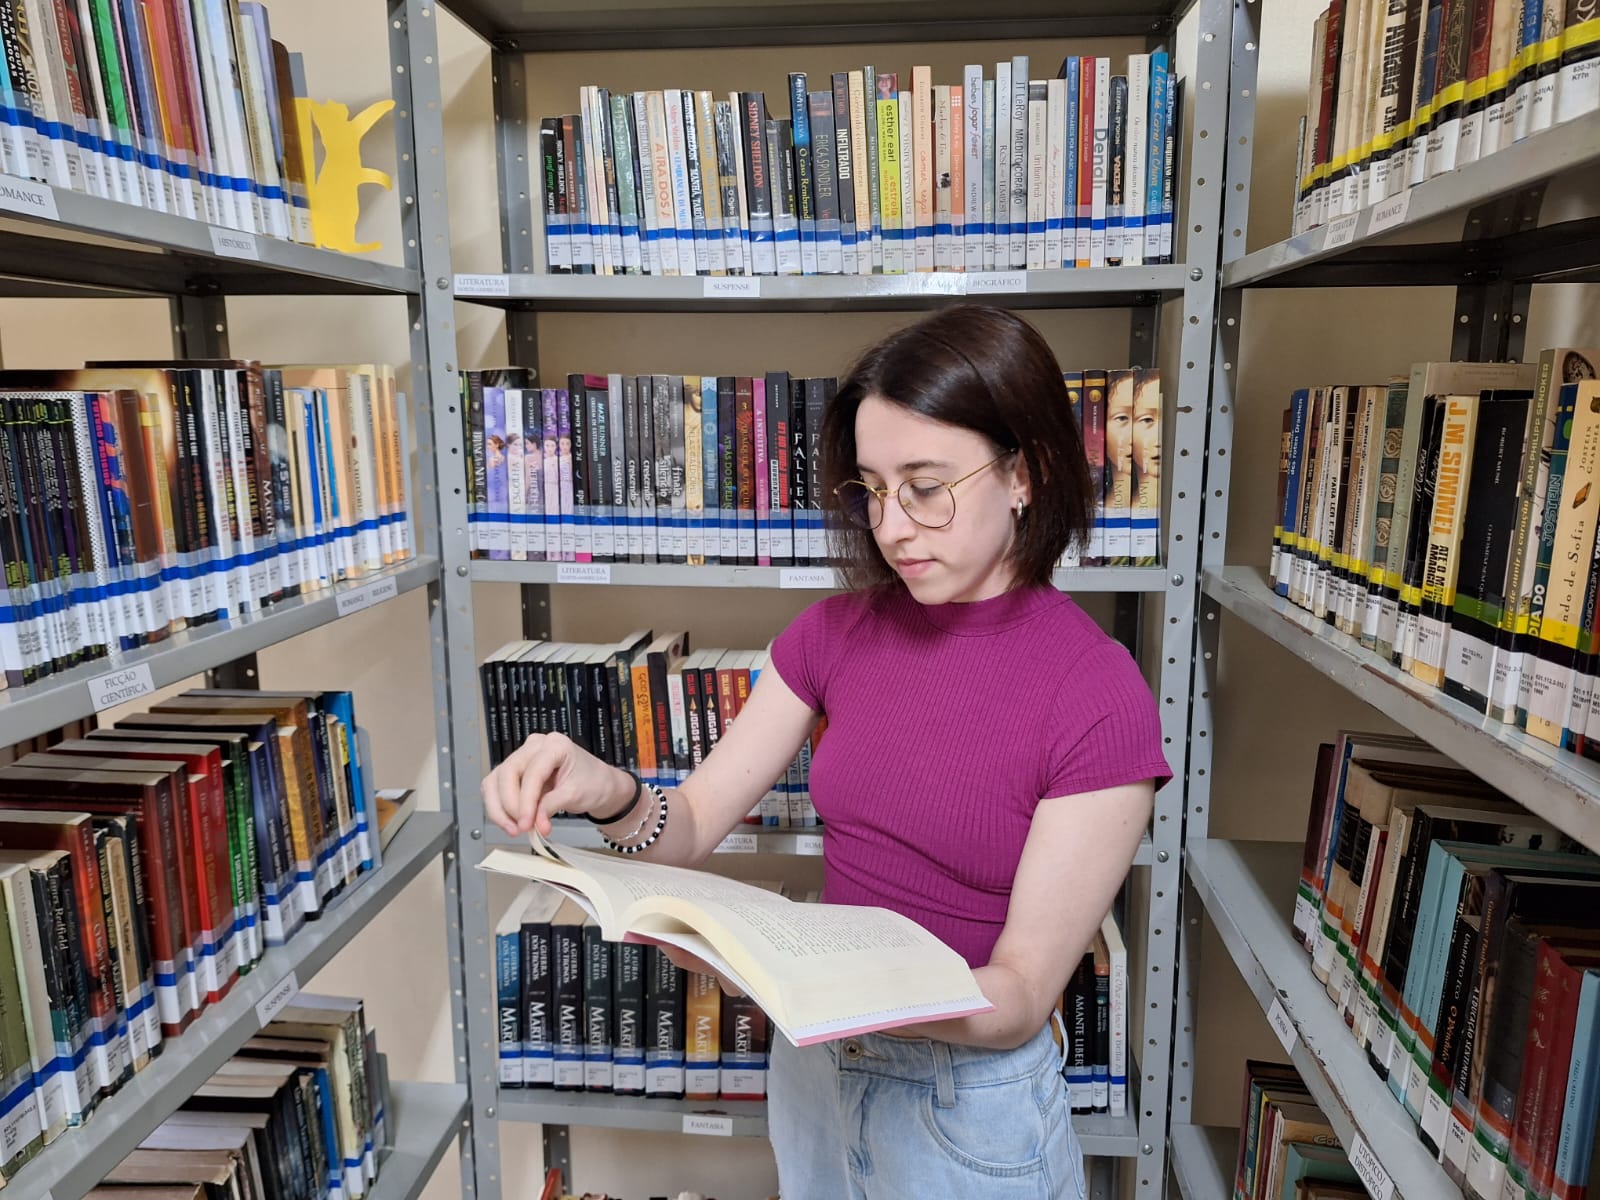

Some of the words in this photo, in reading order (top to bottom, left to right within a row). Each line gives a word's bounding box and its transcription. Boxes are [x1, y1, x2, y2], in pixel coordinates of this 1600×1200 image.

[1, 7, 10, 35] PARA
[1015, 80, 1025, 93] JT
[1154, 75, 1166, 96] Arte
[968, 104, 980, 131] jogar
[1013, 94, 1025, 120] LeRoy
[1154, 99, 1163, 109] de
[747, 101, 760, 138] SIDNEY
[886, 104, 895, 139] esther
[1152, 112, 1163, 142] Correr
[655, 143, 664, 153] A
[799, 148, 807, 157] O
[815, 134, 829, 157] ERICA
[836, 128, 850, 180] INFILTRADO
[887, 142, 897, 162] earl
[1014, 129, 1024, 165] MALDITO
[1093, 128, 1108, 189] Denali
[656, 156, 667, 178] IRA
[751, 140, 764, 188] SHELDON
[1113, 155, 1121, 192] PEDRA
[1151, 158, 1162, 188] Chuva
[817, 159, 831, 199] SPINDLER
[1014, 166, 1026, 205] CORAÇÃO
[0, 186, 45, 206] OMANCE
[659, 181, 669, 209] DOS
[890, 181, 898, 216] estrela
[1536, 363, 1549, 416] SENDKER
[92, 400, 104, 438] FUTURO
[187, 413, 196, 440] PITTACUS
[218, 411, 227, 439] PITTACUS
[240, 409, 249, 434] PITTACUS
[596, 403, 604, 425] MAZE
[1293, 398, 1303, 434] Drachen
[189, 442, 198, 456] LORE
[221, 439, 229, 452] LORE
[243, 436, 252, 449] LORE
[598, 426, 607, 457] RUNNER
[725, 435, 733, 460] ATRÁS
[757, 418, 765, 463] INTUITIVA
[1290, 436, 1299, 459] roten
[1525, 417, 1541, 486] JAN-PHILIPP
[1578, 425, 1591, 470] JOSTEIN
[1586, 423, 1600, 475] GAARDER
[97, 439, 111, 486] PROIBIDO
[725, 462, 732, 475] DO
[794, 433, 806, 509] FALLEN
[811, 433, 821, 509] FALLEN
[613, 460, 623, 505] sussurro
[629, 460, 638, 500] crescendo
[643, 460, 652, 500] crescendo
[671, 466, 683, 497] finale
[282, 486, 291, 511] ONDA
[1542, 474, 1562, 547] JOSTEIN
[1517, 500, 1531, 546] coração
[1567, 519, 1585, 563] Sofia
[561, 567, 607, 575] LITERATURA
[1426, 544, 1440, 587] AMARGO
[1510, 557, 1521, 587] ouvir
[1563, 569, 1577, 587] de
[1507, 590, 1516, 602] de
[1532, 584, 1546, 606] DO
[1527, 610, 1543, 637] DIA
[100, 682, 148, 705] CIENTÍFICA
[104, 670, 137, 689] FICÇÃO
[639, 673, 648, 692] GOD
[738, 677, 747, 698] COLLINS
[641, 705, 650, 725] WAR
[690, 710, 701, 741] JOGOS
[706, 709, 718, 740] JOGOS
[18, 881, 28, 907] ANITA
[48, 875, 62, 905] James
[55, 908, 69, 950] Redfield
[531, 935, 539, 950] DOS
[592, 944, 600, 958] DOS
[623, 946, 631, 963] DOS
[1458, 933, 1472, 977] UMBERTO
[503, 955, 511, 987] TRONOS
[510, 950, 518, 981] GUERRA
[532, 951, 540, 980] TRONOS
[540, 944, 548, 976] GUERRA
[562, 955, 570, 984] TRONOS
[570, 948, 578, 980] GUERRA
[593, 960, 601, 980] REIS
[600, 953, 608, 978] FÚRIA
[624, 965, 632, 983] REIS
[631, 956, 639, 980] FÚRIA
[1454, 980, 1465, 1000] ECO
[1075, 994, 1085, 1036] AMANTE
[1450, 1005, 1458, 1016] O
[1466, 995, 1480, 1039] EDUCAÇÃO
